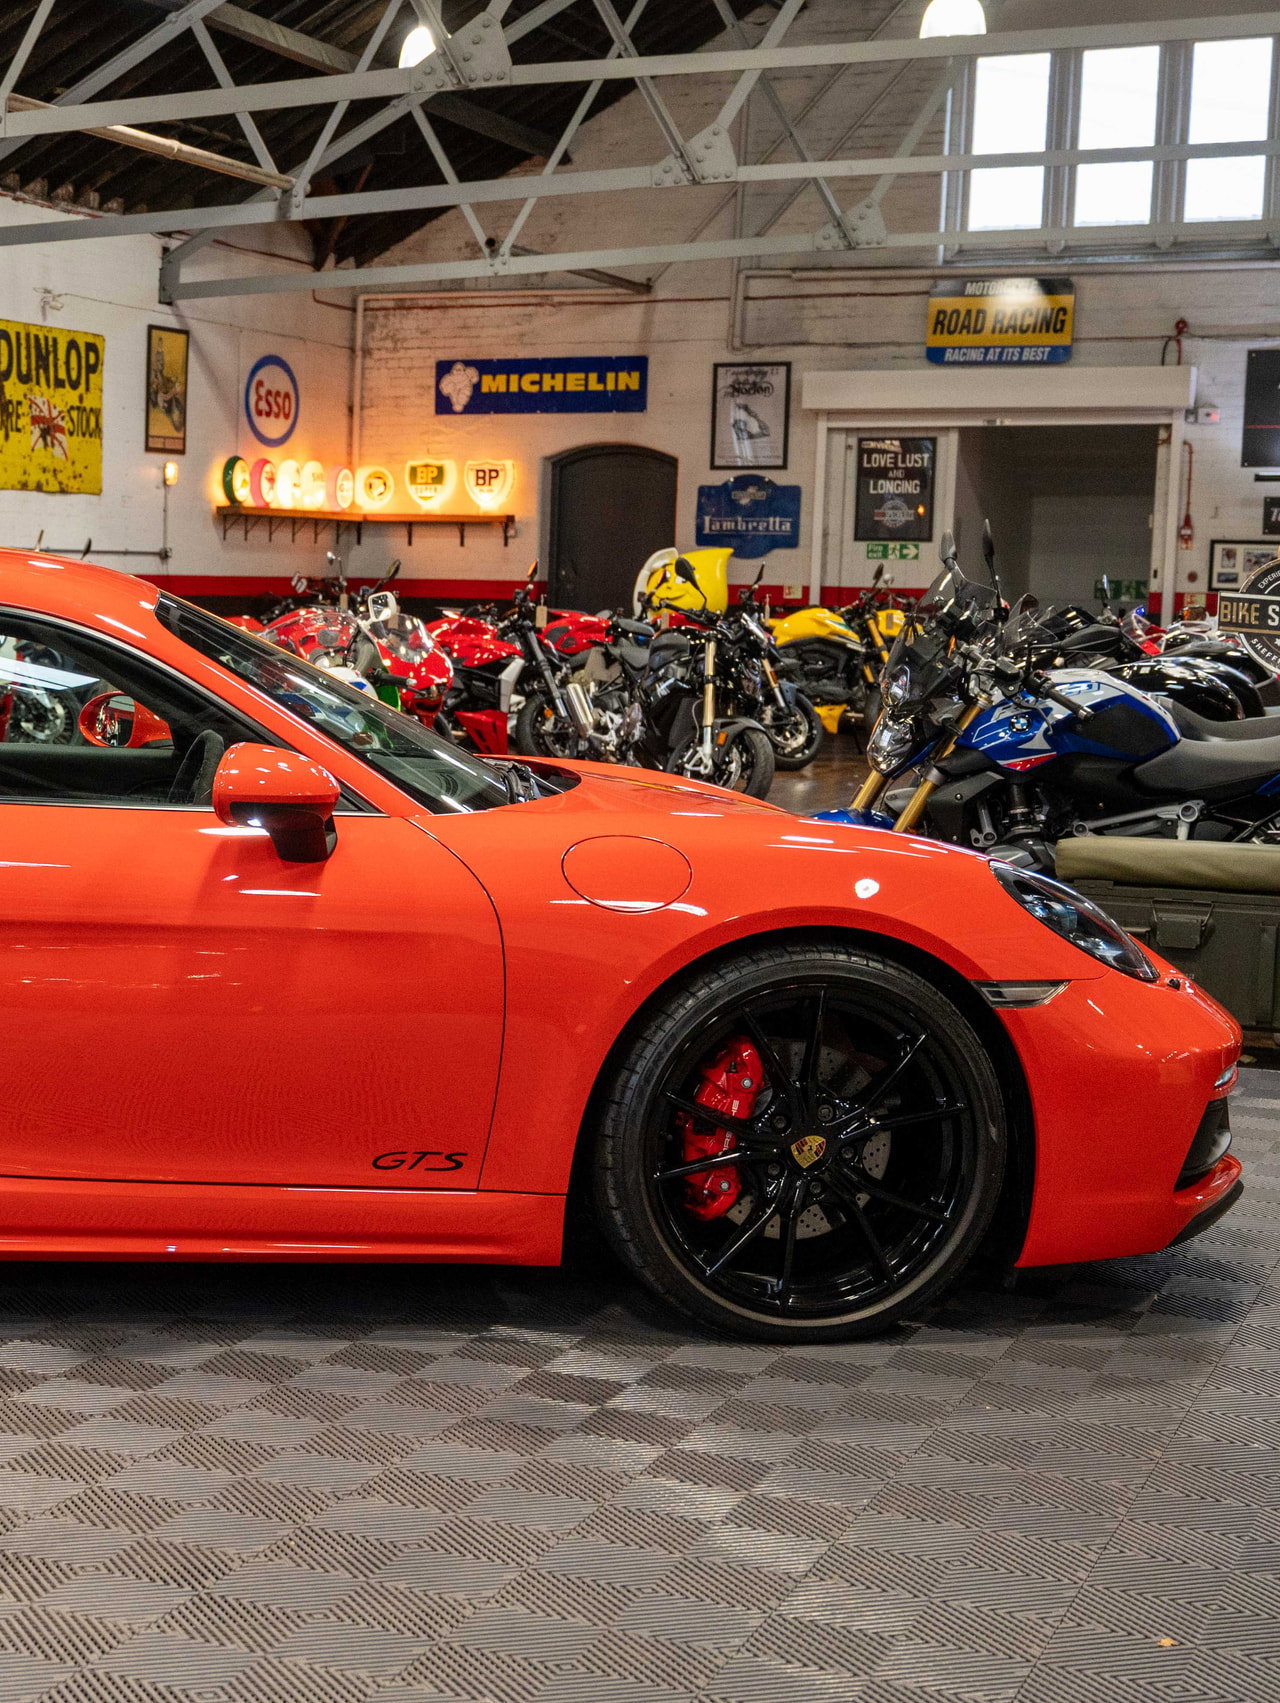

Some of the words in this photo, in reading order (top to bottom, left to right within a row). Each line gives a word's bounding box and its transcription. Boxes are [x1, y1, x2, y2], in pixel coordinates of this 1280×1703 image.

[932, 308, 987, 335] ROAD
[991, 307, 1068, 334] RACING
[944, 348, 985, 361] RACING
[986, 349, 1001, 360] AT
[1002, 348, 1020, 360] ITS
[1022, 347, 1052, 360] BEST
[481, 371, 640, 393] MICHELIN
[254, 380, 291, 420] Esso
[67, 404, 101, 440] STOCK
[863, 453, 896, 468] LOVE
[898, 453, 930, 468] LUST
[415, 466, 439, 484] BP
[475, 469, 499, 486] BP
[869, 480, 921, 494] LONGING
[1220, 601, 1260, 625] BIKE
[372, 1151, 469, 1171] GTS
